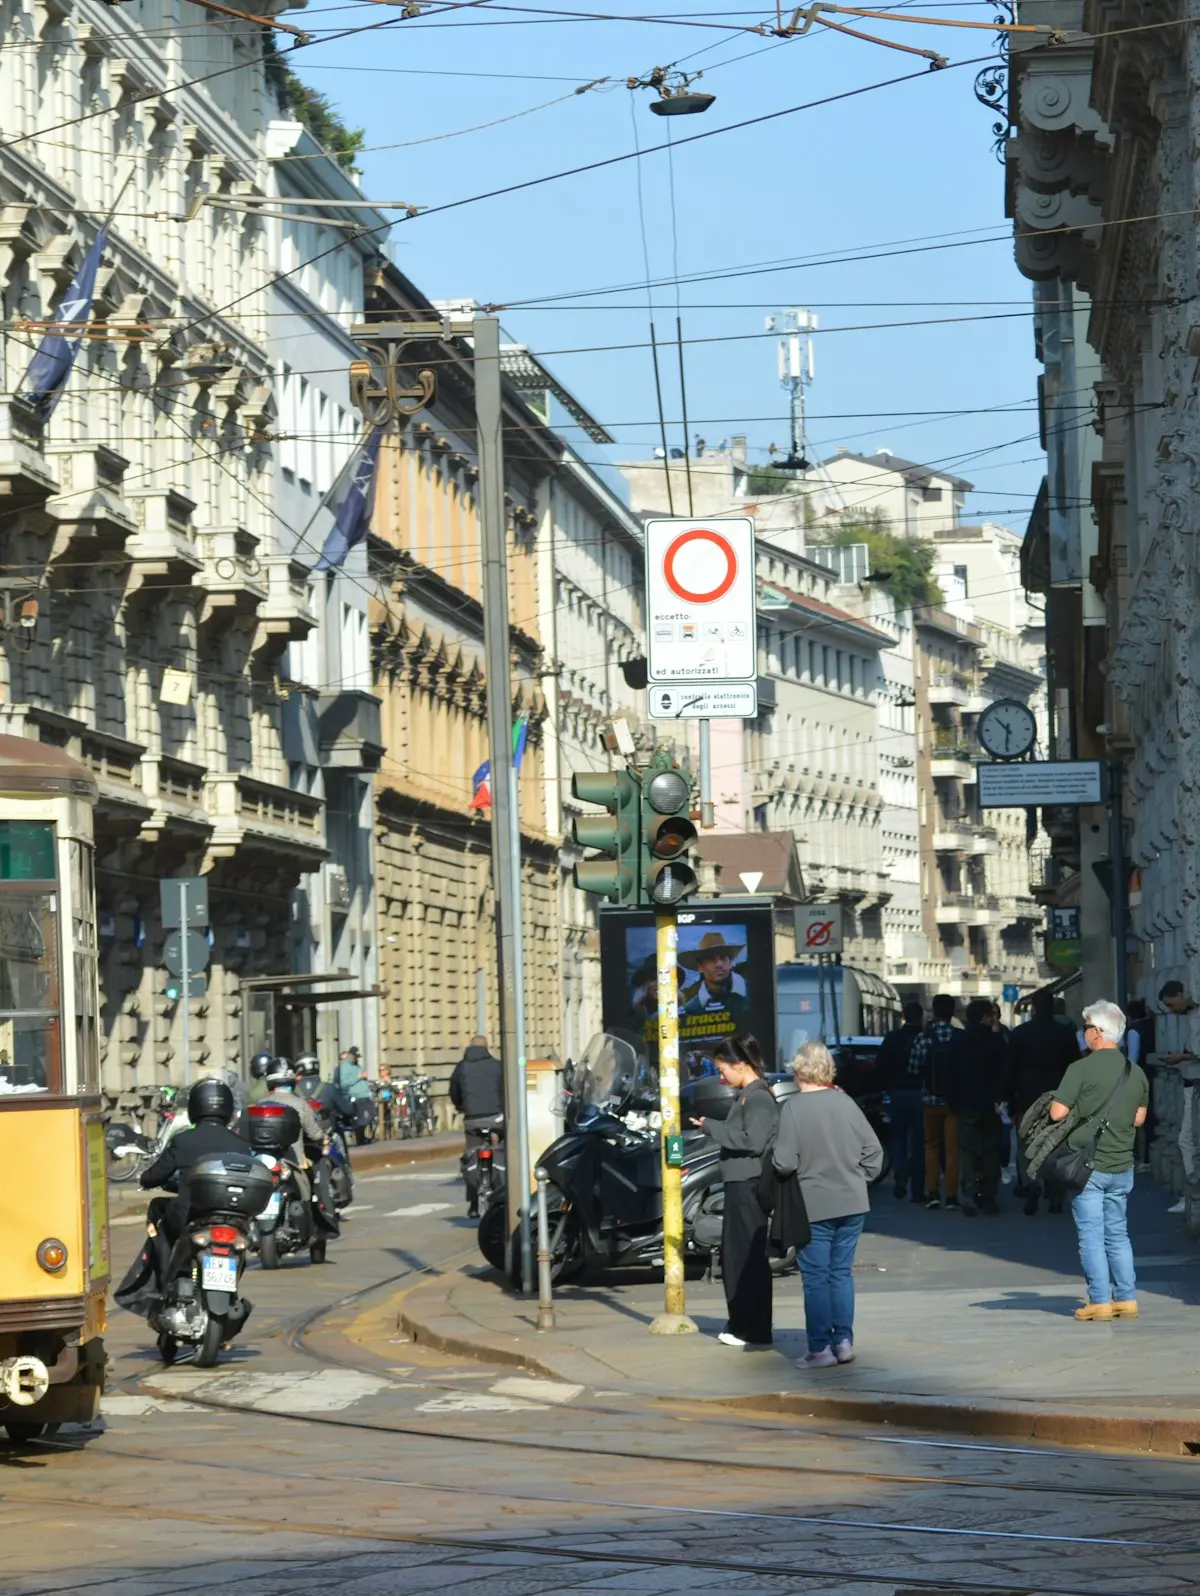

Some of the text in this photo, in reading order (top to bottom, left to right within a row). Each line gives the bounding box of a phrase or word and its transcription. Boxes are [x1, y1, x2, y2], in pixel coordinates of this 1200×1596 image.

[654, 612, 692, 621] eccetto:
[655, 666, 719, 676] ed autorizzati
[172, 681, 181, 692] 7
